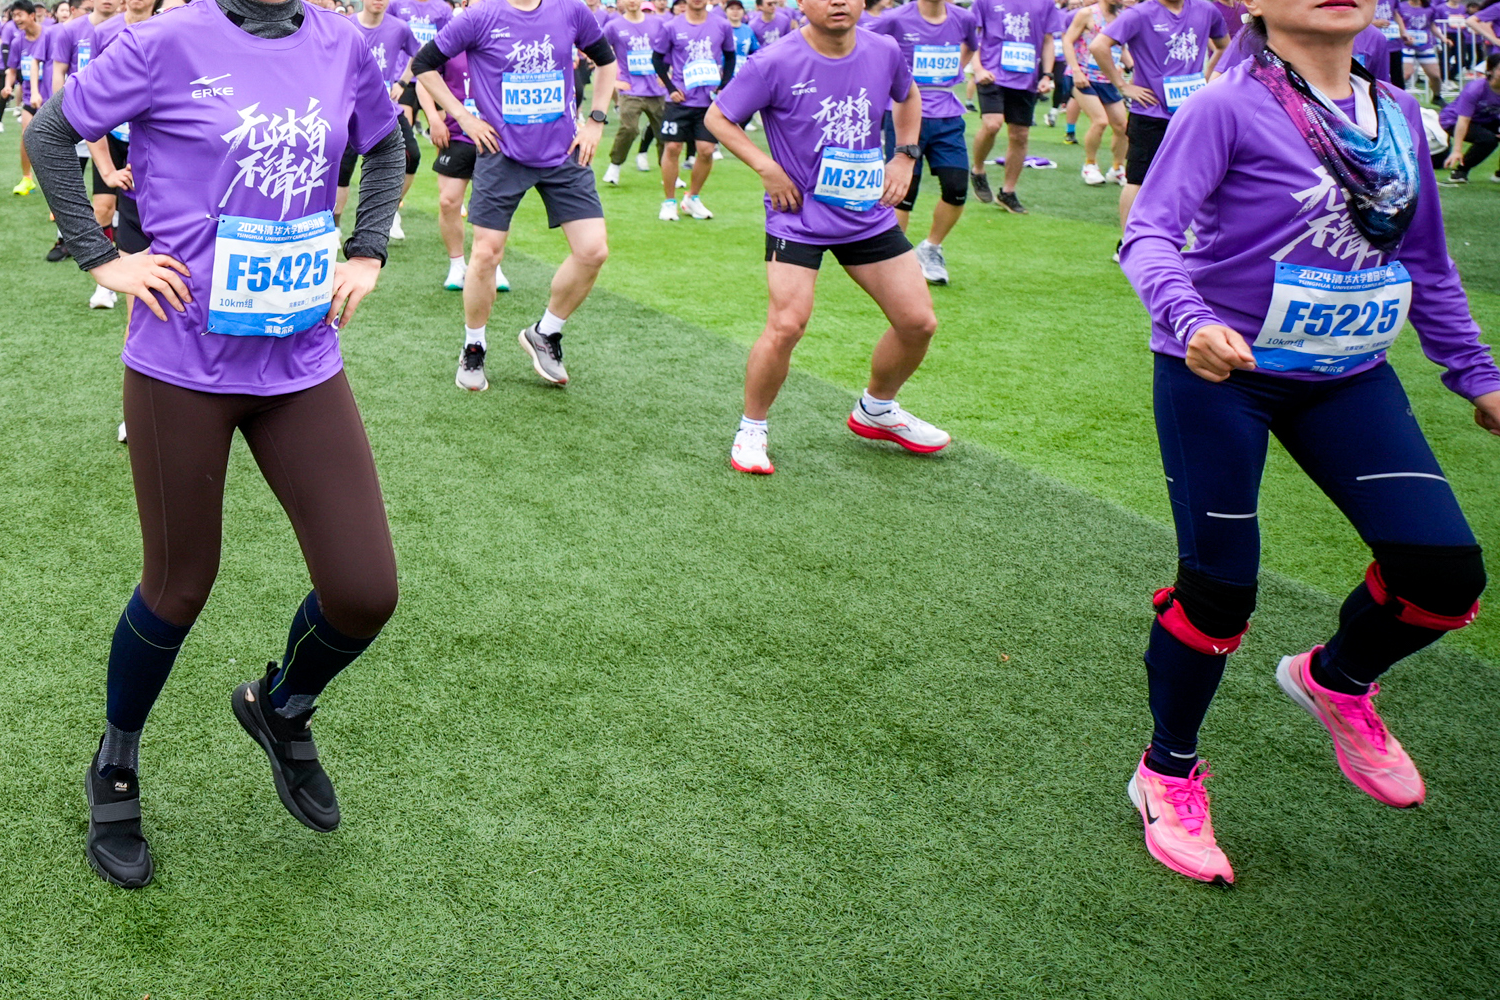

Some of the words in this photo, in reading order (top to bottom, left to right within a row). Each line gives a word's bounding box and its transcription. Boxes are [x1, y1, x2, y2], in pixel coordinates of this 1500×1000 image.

[916, 57, 959, 70] M4929
[191, 87, 234, 99] ERKE
[505, 87, 563, 105] M3324
[792, 87, 817, 95] ERKE
[219, 97, 332, 166] 无体育
[661, 120, 678, 135] 23
[218, 146, 337, 222] 不清华
[821, 166, 883, 189] M3240
[226, 248, 329, 292] F5425
[219, 298, 253, 309] 10km组
[1279, 298, 1400, 337] F5225
[1266, 338, 1305, 348] 10km组
